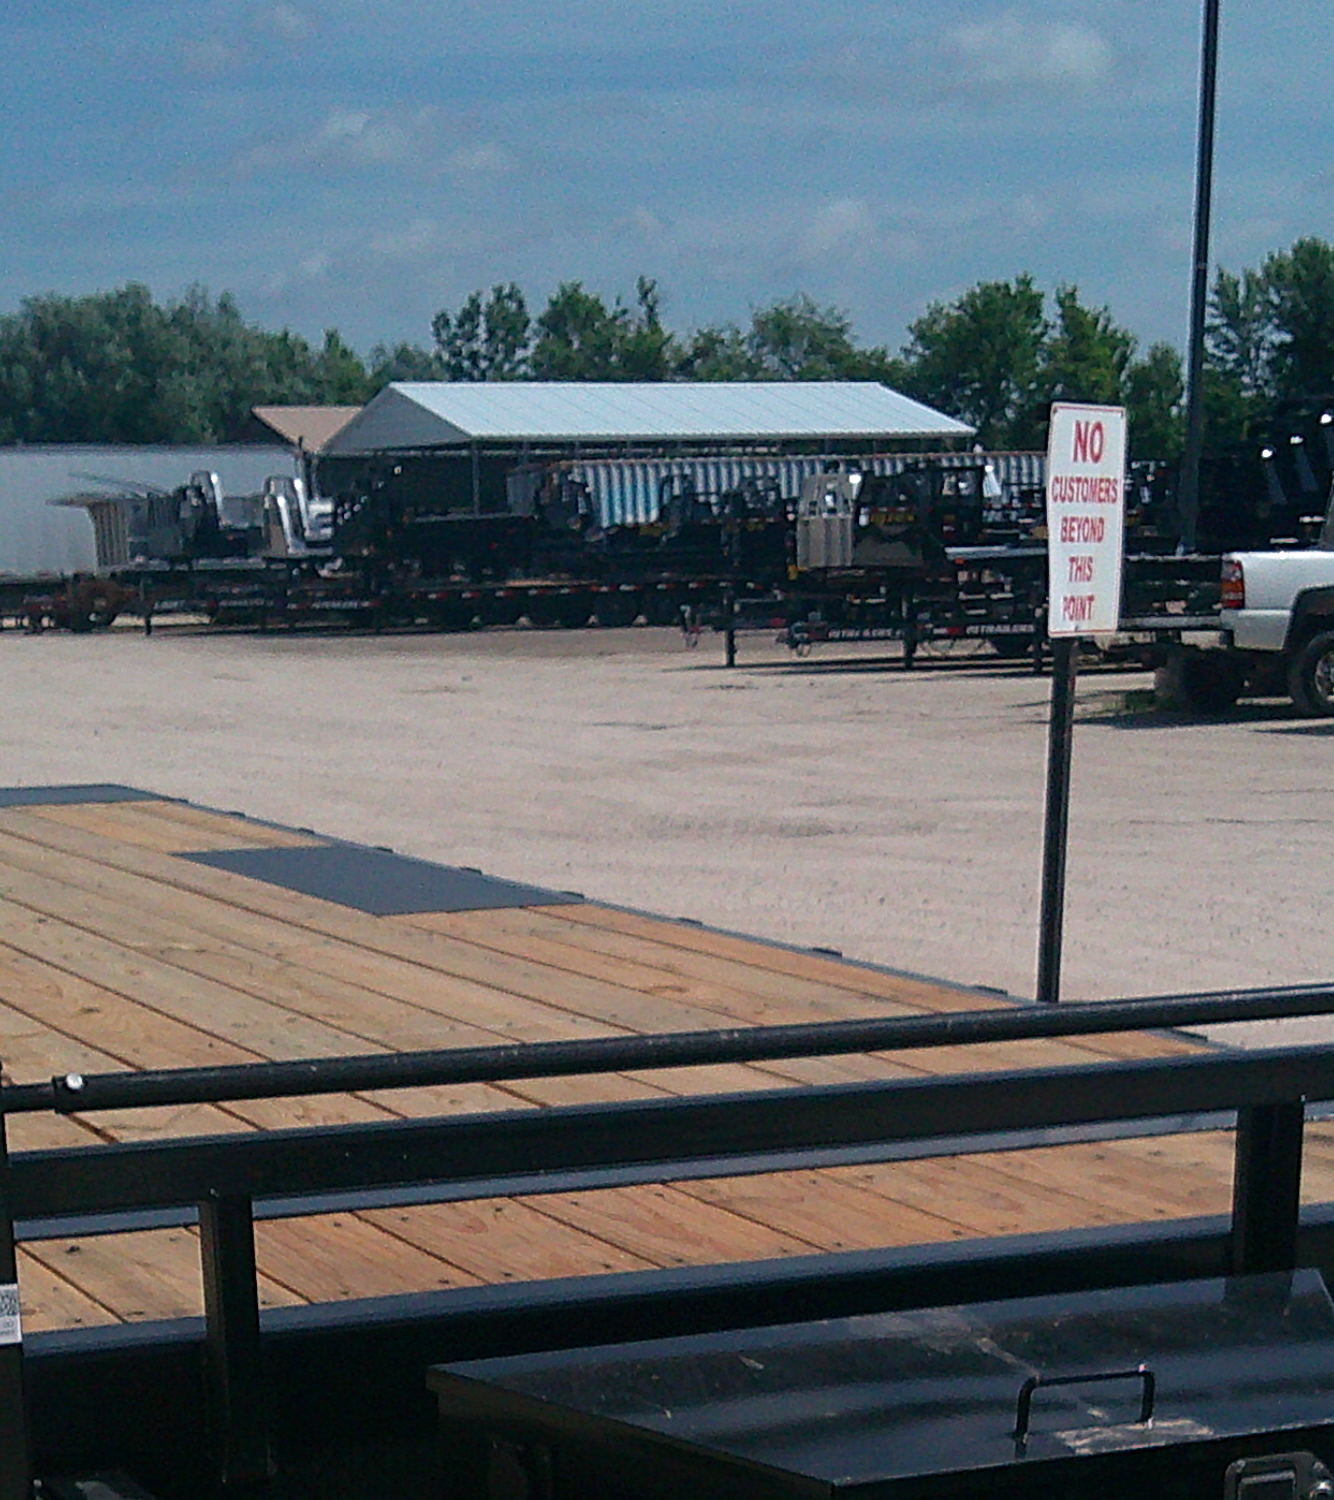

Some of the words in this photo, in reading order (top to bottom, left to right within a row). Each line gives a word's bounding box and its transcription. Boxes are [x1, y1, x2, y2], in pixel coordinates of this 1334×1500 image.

[1073, 420, 1104, 464] NO
[1051, 476, 1118, 504] CUSTOMERS
[1060, 516, 1105, 543] BEYOND
[1068, 556, 1094, 582] THIS
[1063, 595, 1095, 622] POINT
